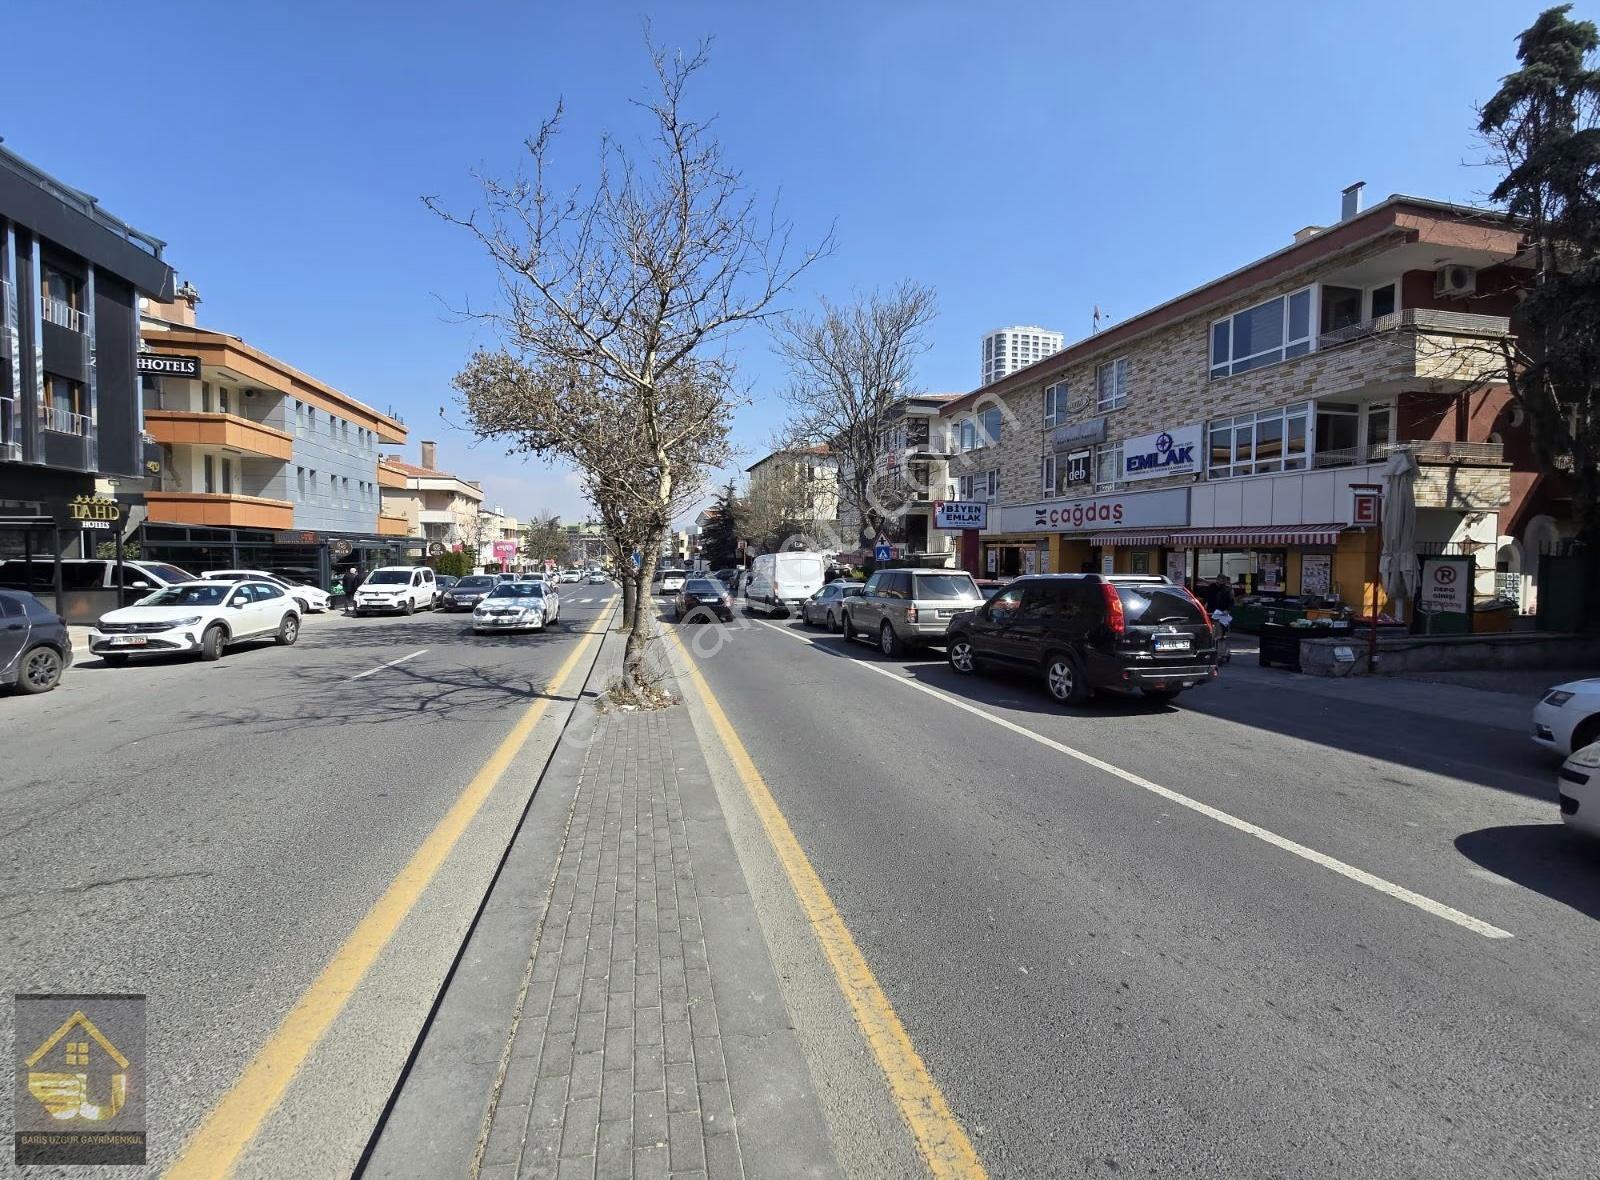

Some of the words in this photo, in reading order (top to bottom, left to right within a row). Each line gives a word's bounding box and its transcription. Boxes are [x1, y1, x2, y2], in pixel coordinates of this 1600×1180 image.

[1126, 446, 1194, 472] EMLAK
[70, 503, 120, 520] TAHD
[946, 503, 981, 513] BİYEN
[1049, 501, 1123, 527] çağdaş
[82, 521, 110, 529] HOTELS
